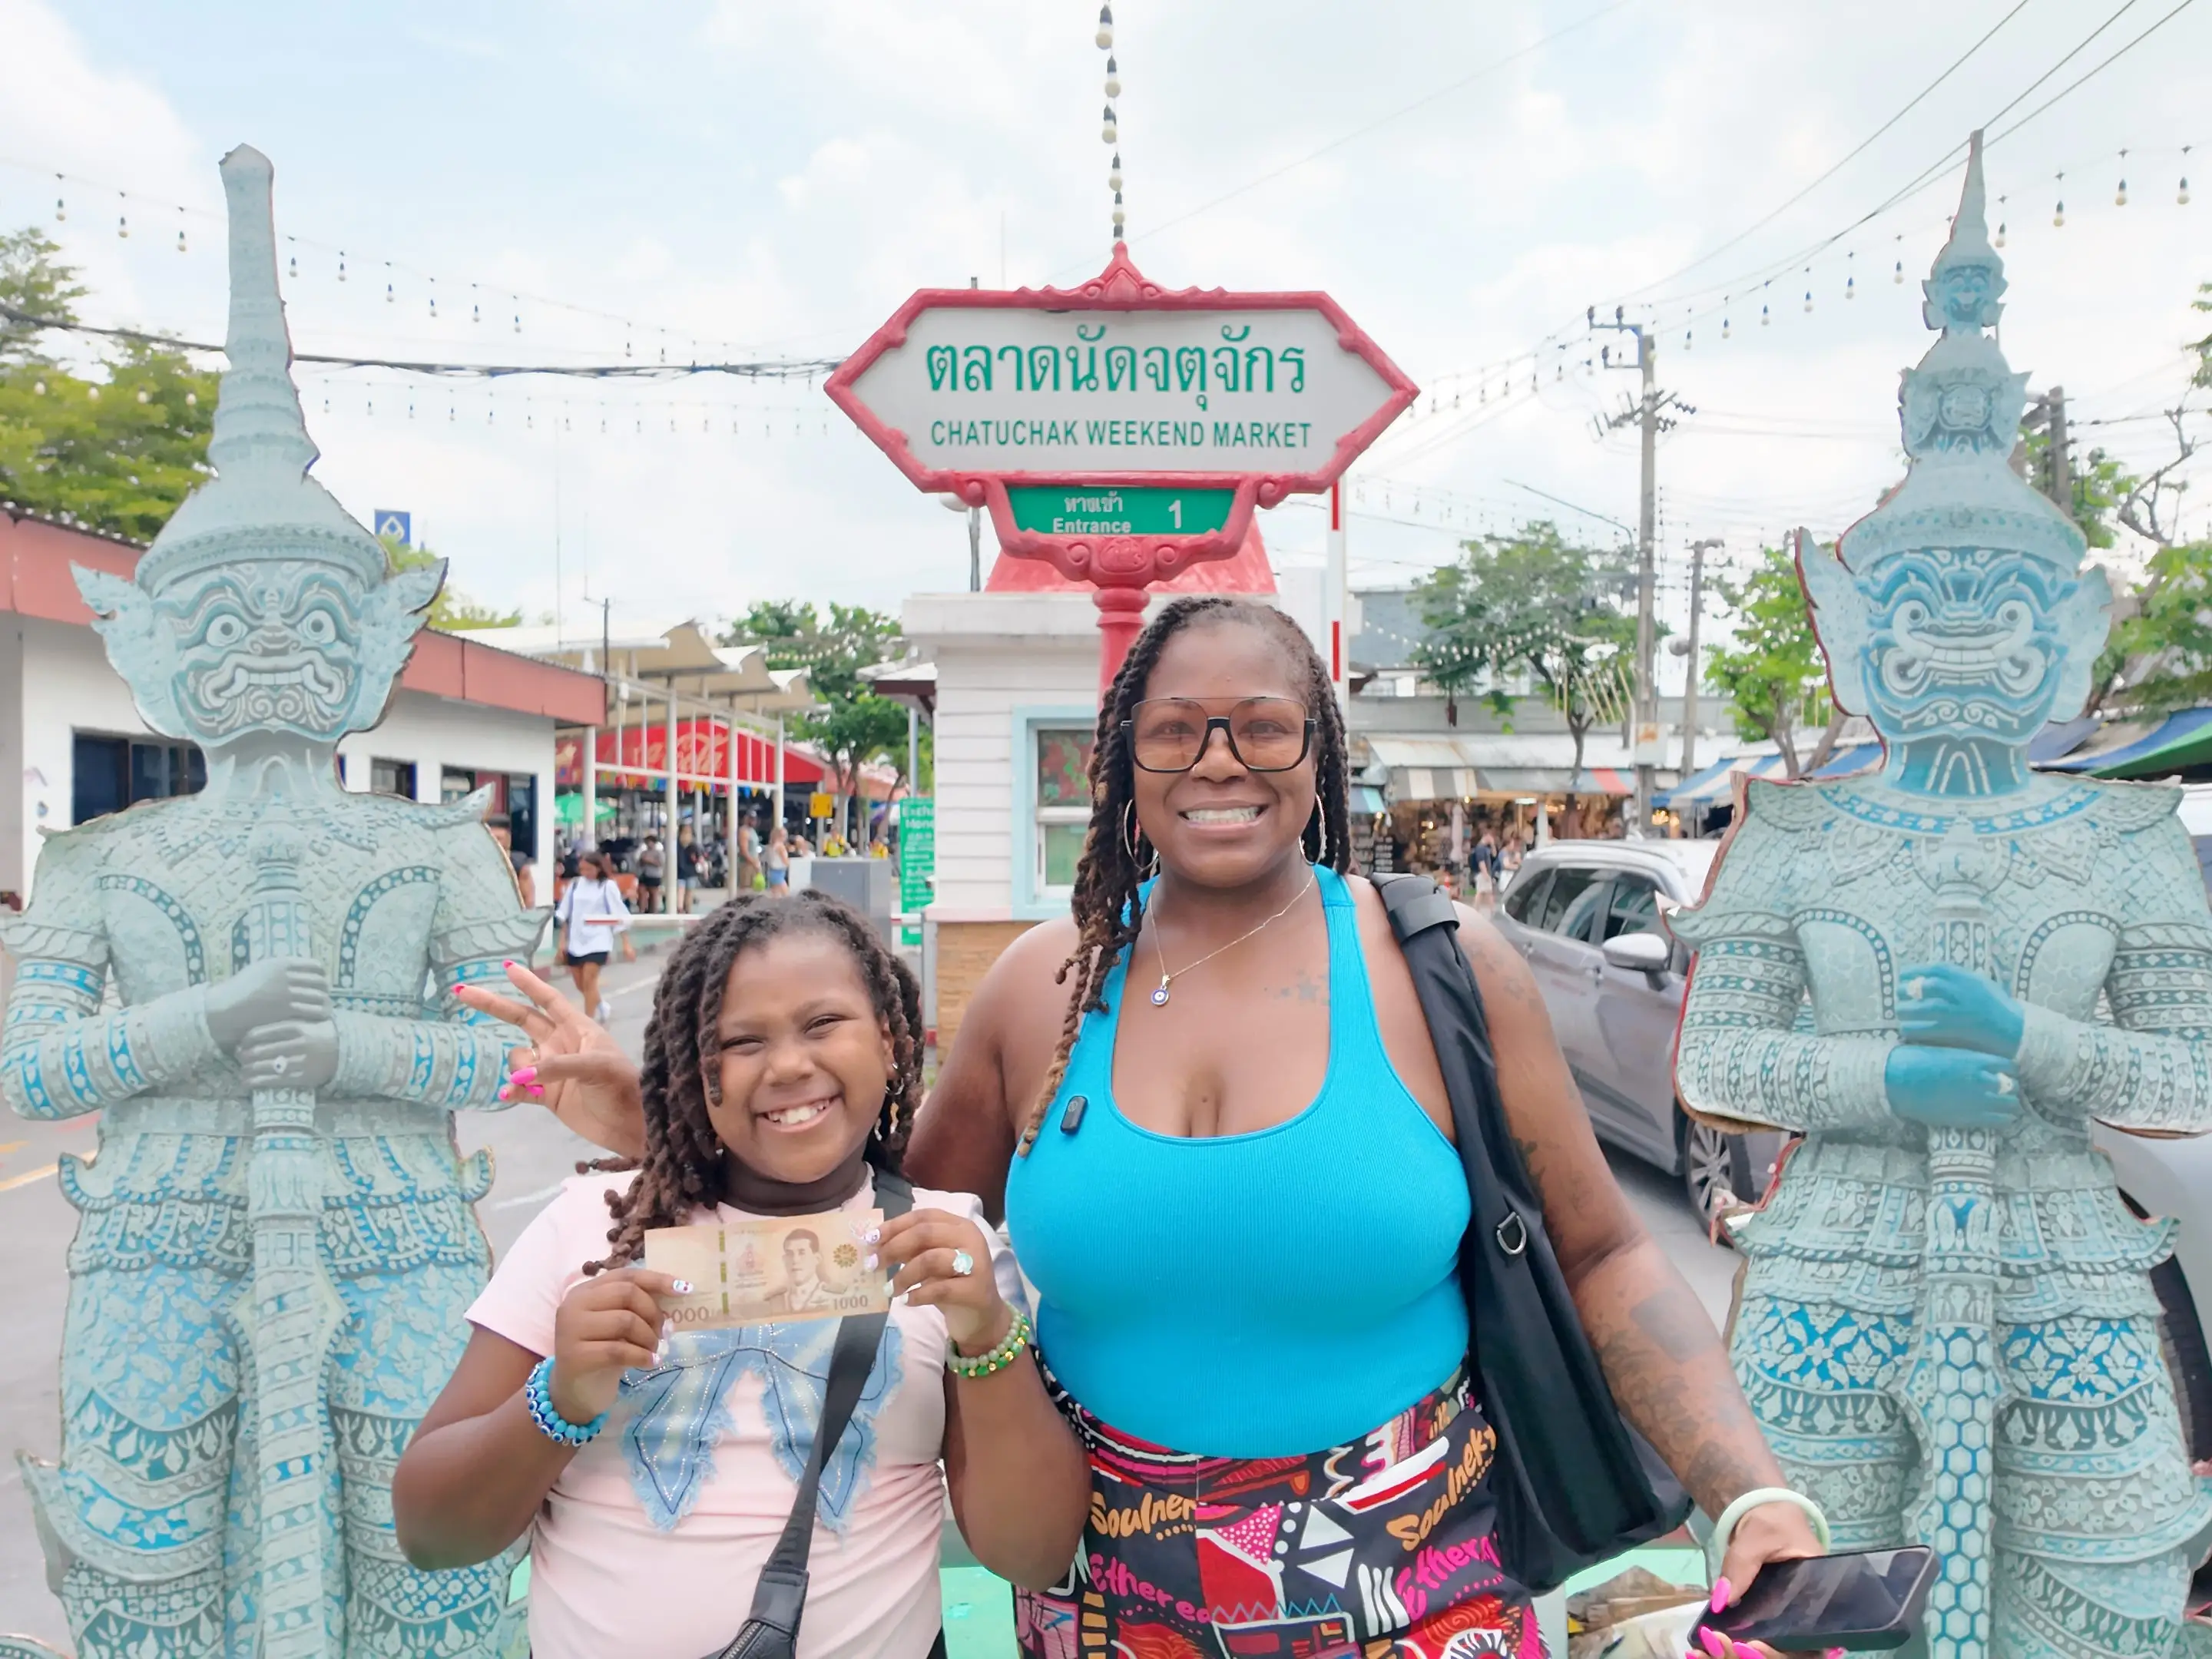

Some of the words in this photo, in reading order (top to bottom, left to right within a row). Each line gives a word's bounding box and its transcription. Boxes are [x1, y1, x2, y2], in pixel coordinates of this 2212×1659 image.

[926, 324, 1306, 412] ตลาดนัดจตุจักร
[931, 420, 1079, 446] CHATUCHAK
[1086, 421, 1205, 447] WEEKEND
[1213, 422, 1312, 448] MARKET
[1064, 491, 1124, 513] ทางเข้า
[1052, 517, 1132, 534] Entrance
[1167, 499, 1183, 530] 1
[832, 1294, 869, 1310] 1000
[661, 1305, 710, 1324] 000
